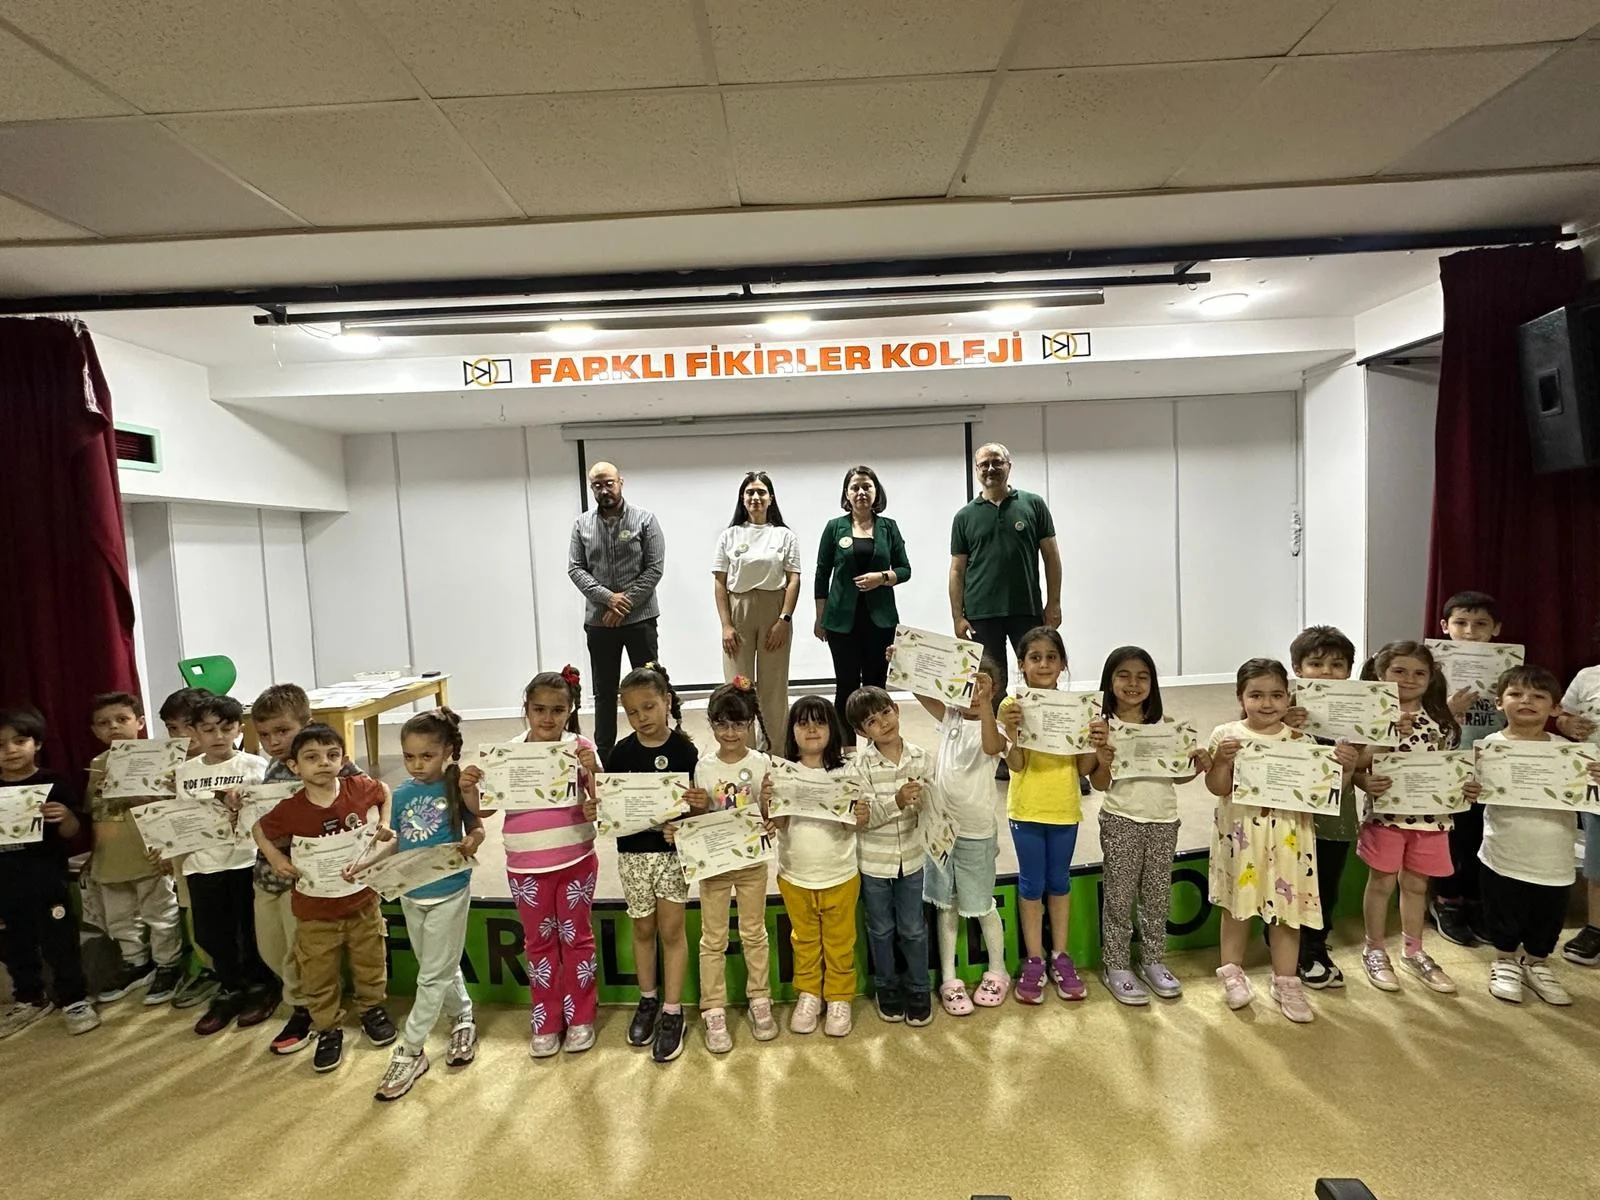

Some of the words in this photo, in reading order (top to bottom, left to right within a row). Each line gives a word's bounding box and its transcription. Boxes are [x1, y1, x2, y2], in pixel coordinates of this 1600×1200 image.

[530, 353, 675, 384] FARKLI
[686, 343, 871, 378] FİKİRLER
[881, 331, 1022, 369] KOLEJİ
[183, 778, 198, 790] RIDE
[200, 776, 213, 788] THE
[214, 775, 244, 786] STREETS
